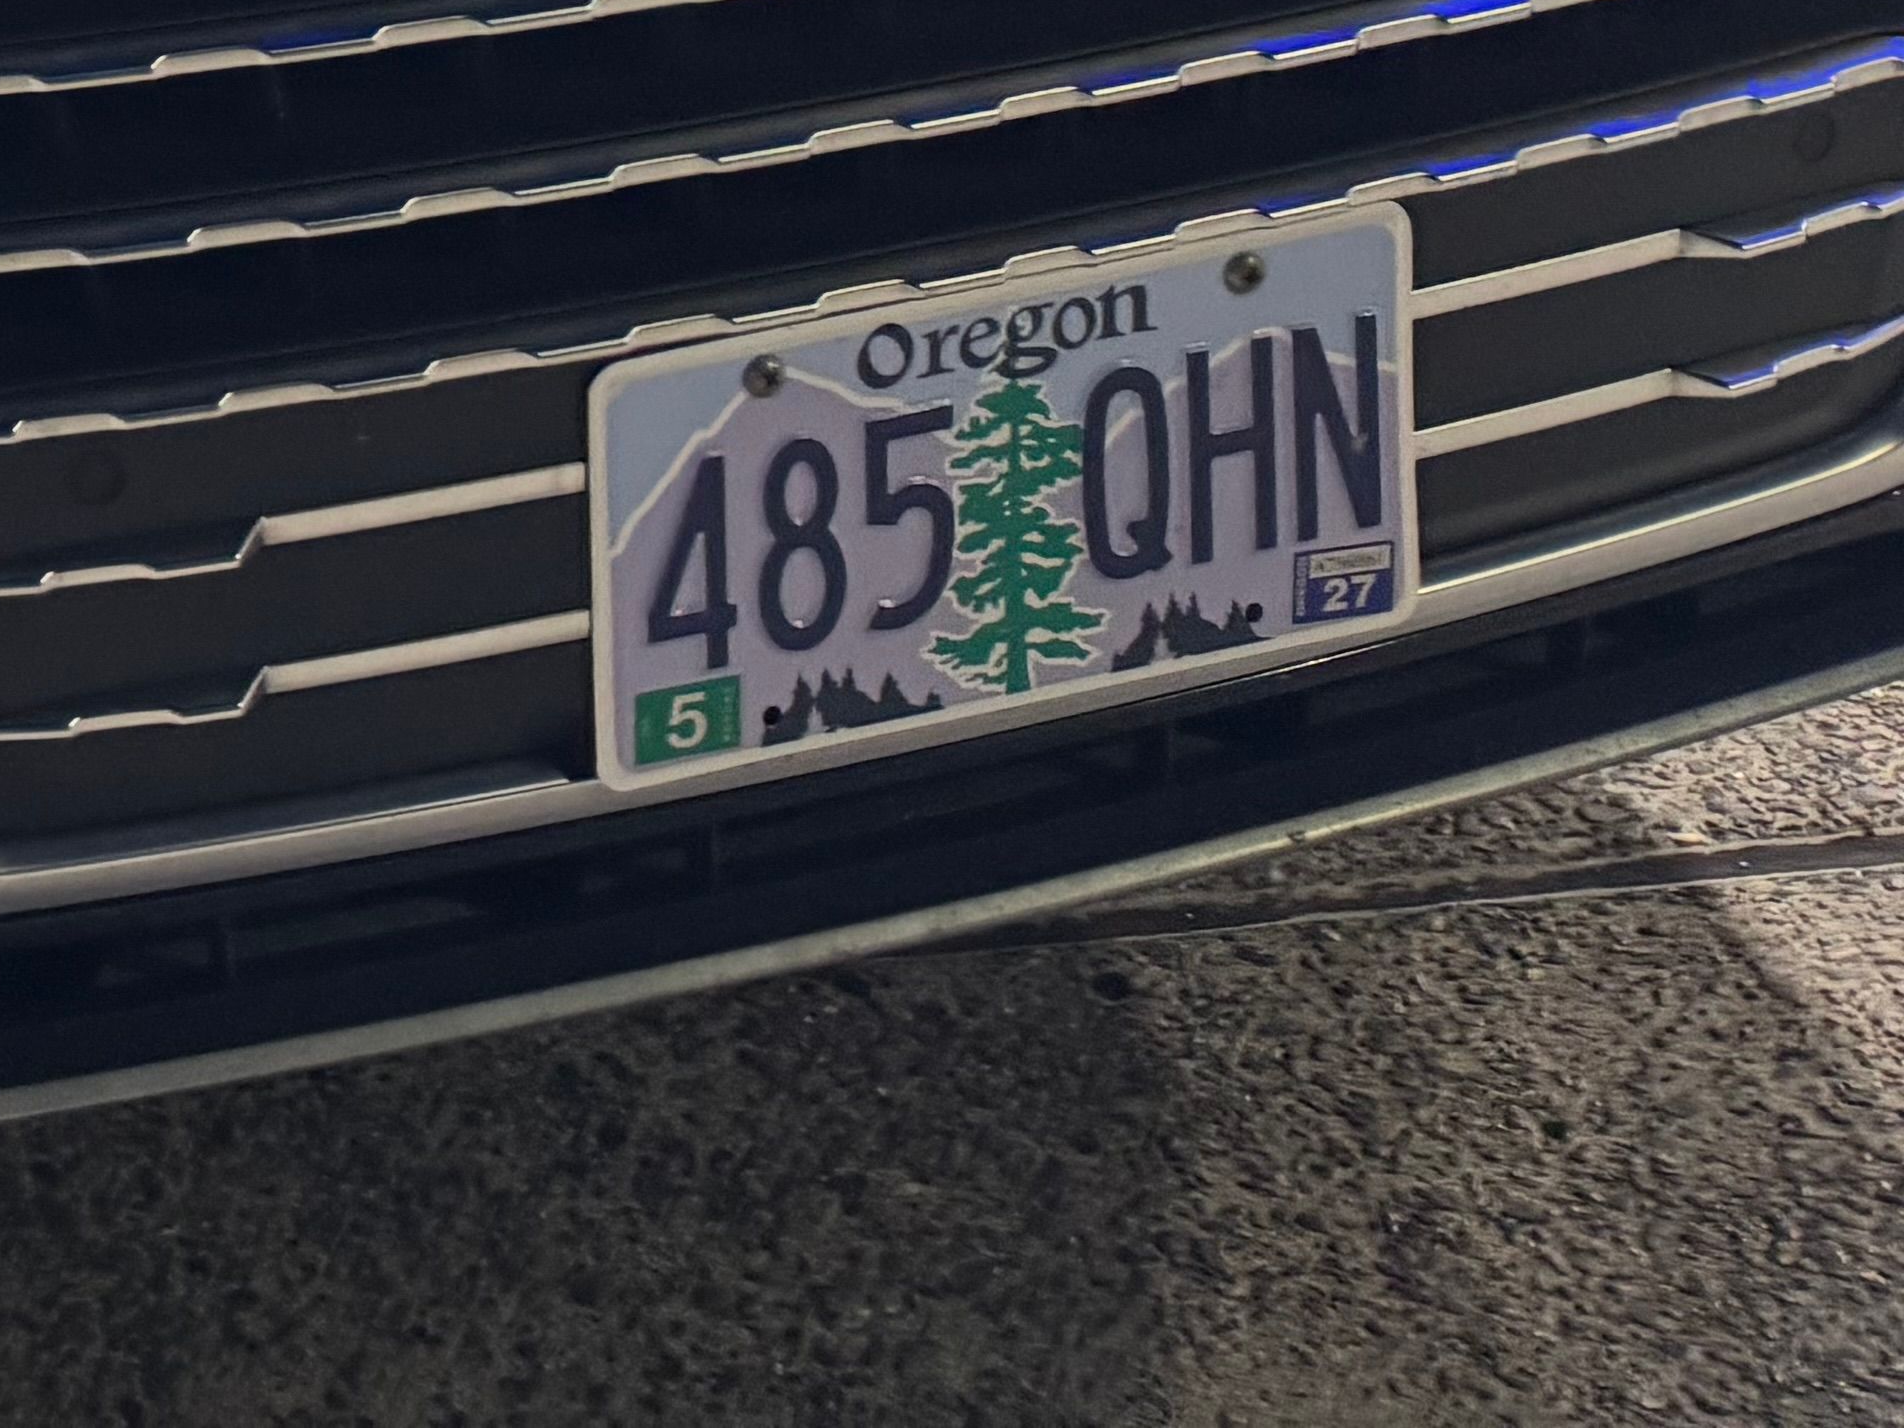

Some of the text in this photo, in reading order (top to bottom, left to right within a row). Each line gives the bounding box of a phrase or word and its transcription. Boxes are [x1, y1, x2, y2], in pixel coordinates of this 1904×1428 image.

[857, 282, 1158, 391] Oregon
[647, 310, 1383, 672] 485 QHN
[1322, 573, 1378, 612] 27
[665, 691, 708, 749] 5
